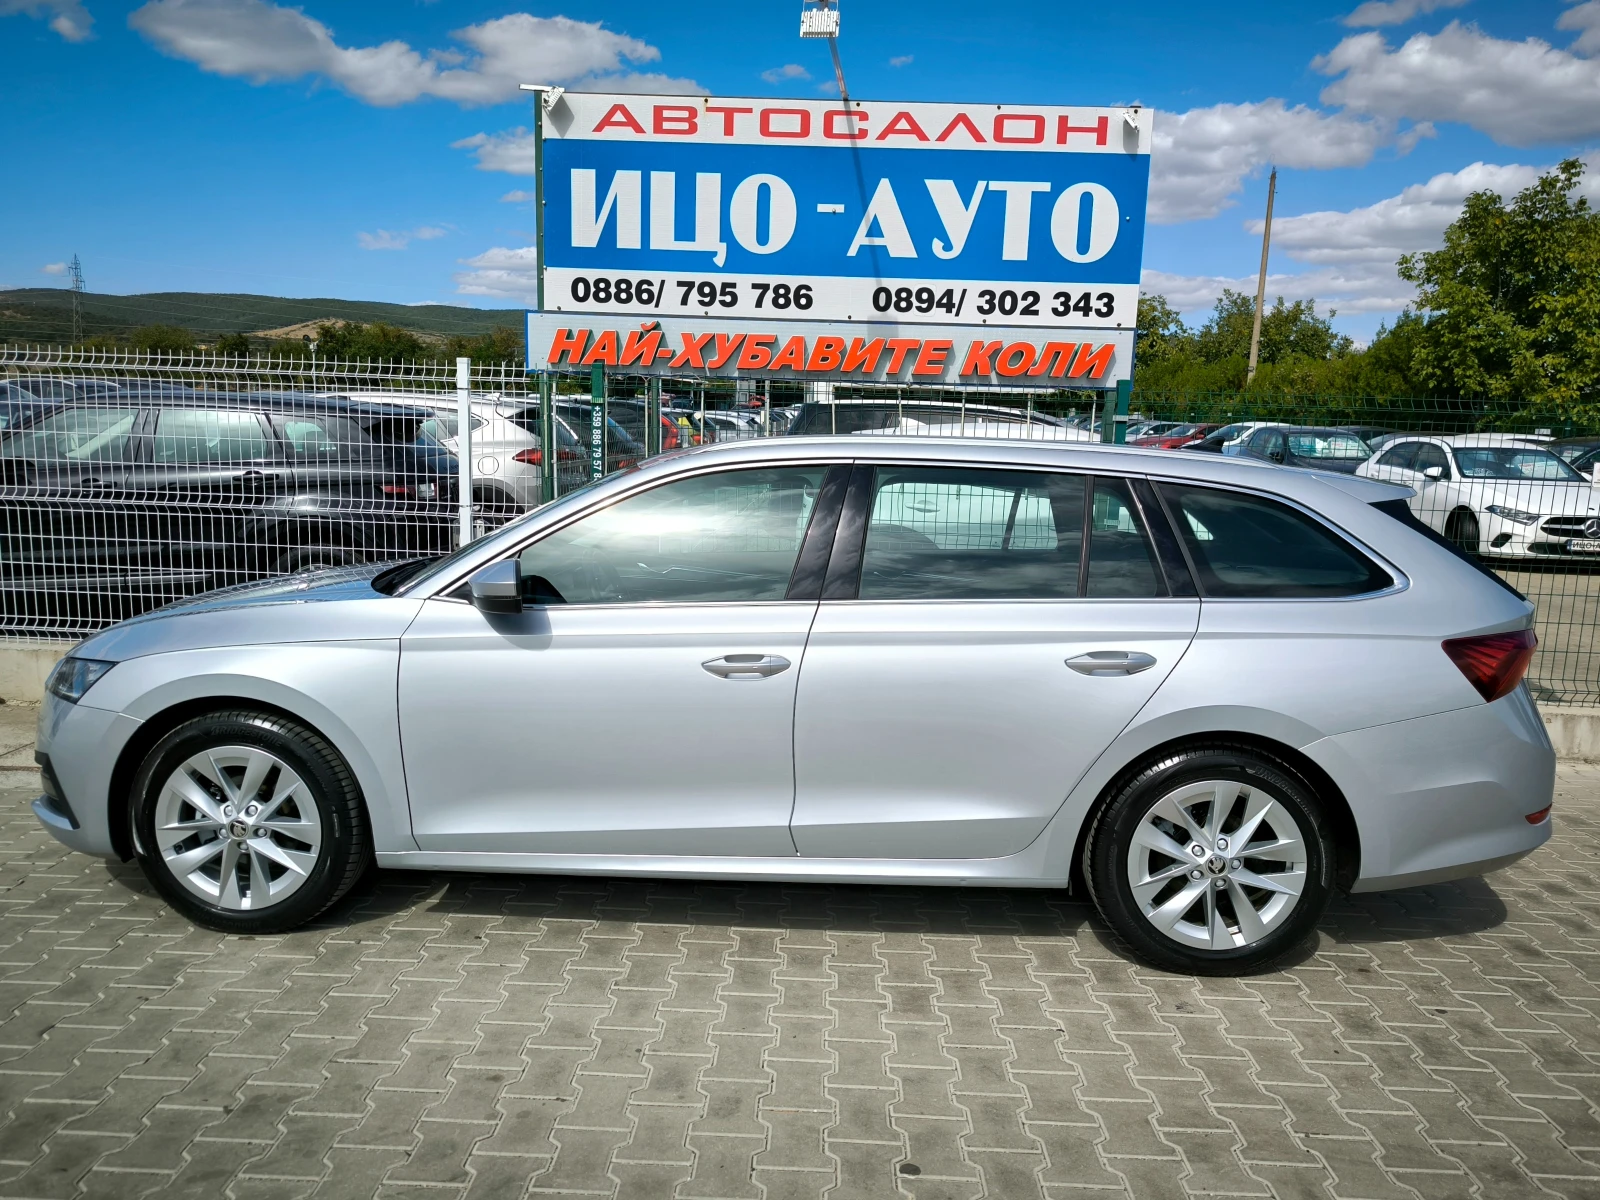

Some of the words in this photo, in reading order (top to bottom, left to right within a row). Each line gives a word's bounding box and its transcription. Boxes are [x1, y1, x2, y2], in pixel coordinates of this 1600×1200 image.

[593, 104, 1109, 147] АВТОСАЛОН
[570, 168, 797, 268] ИЦО
[570, 276, 666, 309] 0886/
[676, 280, 739, 308] 795
[751, 282, 814, 311] 786
[872, 286, 968, 317] 0894/
[976, 289, 1041, 316] 302
[1051, 291, 1115, 319] 343
[547, 322, 953, 375] НАЙ-ХУБАВИТЕ
[961, 340, 1116, 379] КОЛИ
[592, 405, 603, 427] +359
[592, 428, 602, 445] 886
[592, 447, 602, 458] 79
[593, 460, 603, 471] 57
[592, 472, 603, 481] 8
